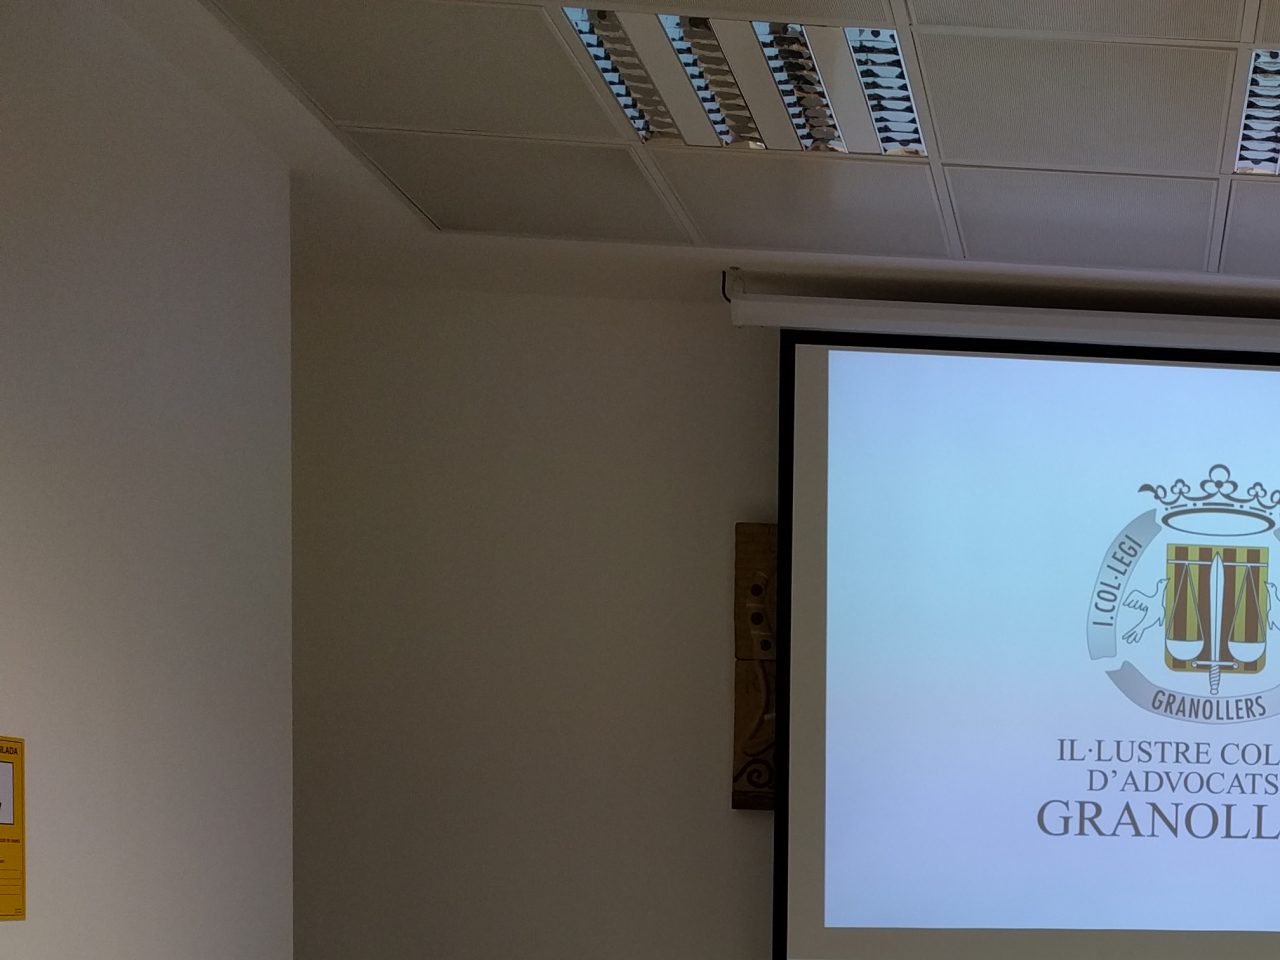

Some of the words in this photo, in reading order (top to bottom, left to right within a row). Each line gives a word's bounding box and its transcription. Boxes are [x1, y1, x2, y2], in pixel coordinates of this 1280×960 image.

[1151, 690, 1266, 721] GRANOLLERS
[1058, 738, 1211, 765] IL·LUSTRE
[1087, 770, 1279, 796] D'ADVOCATS
